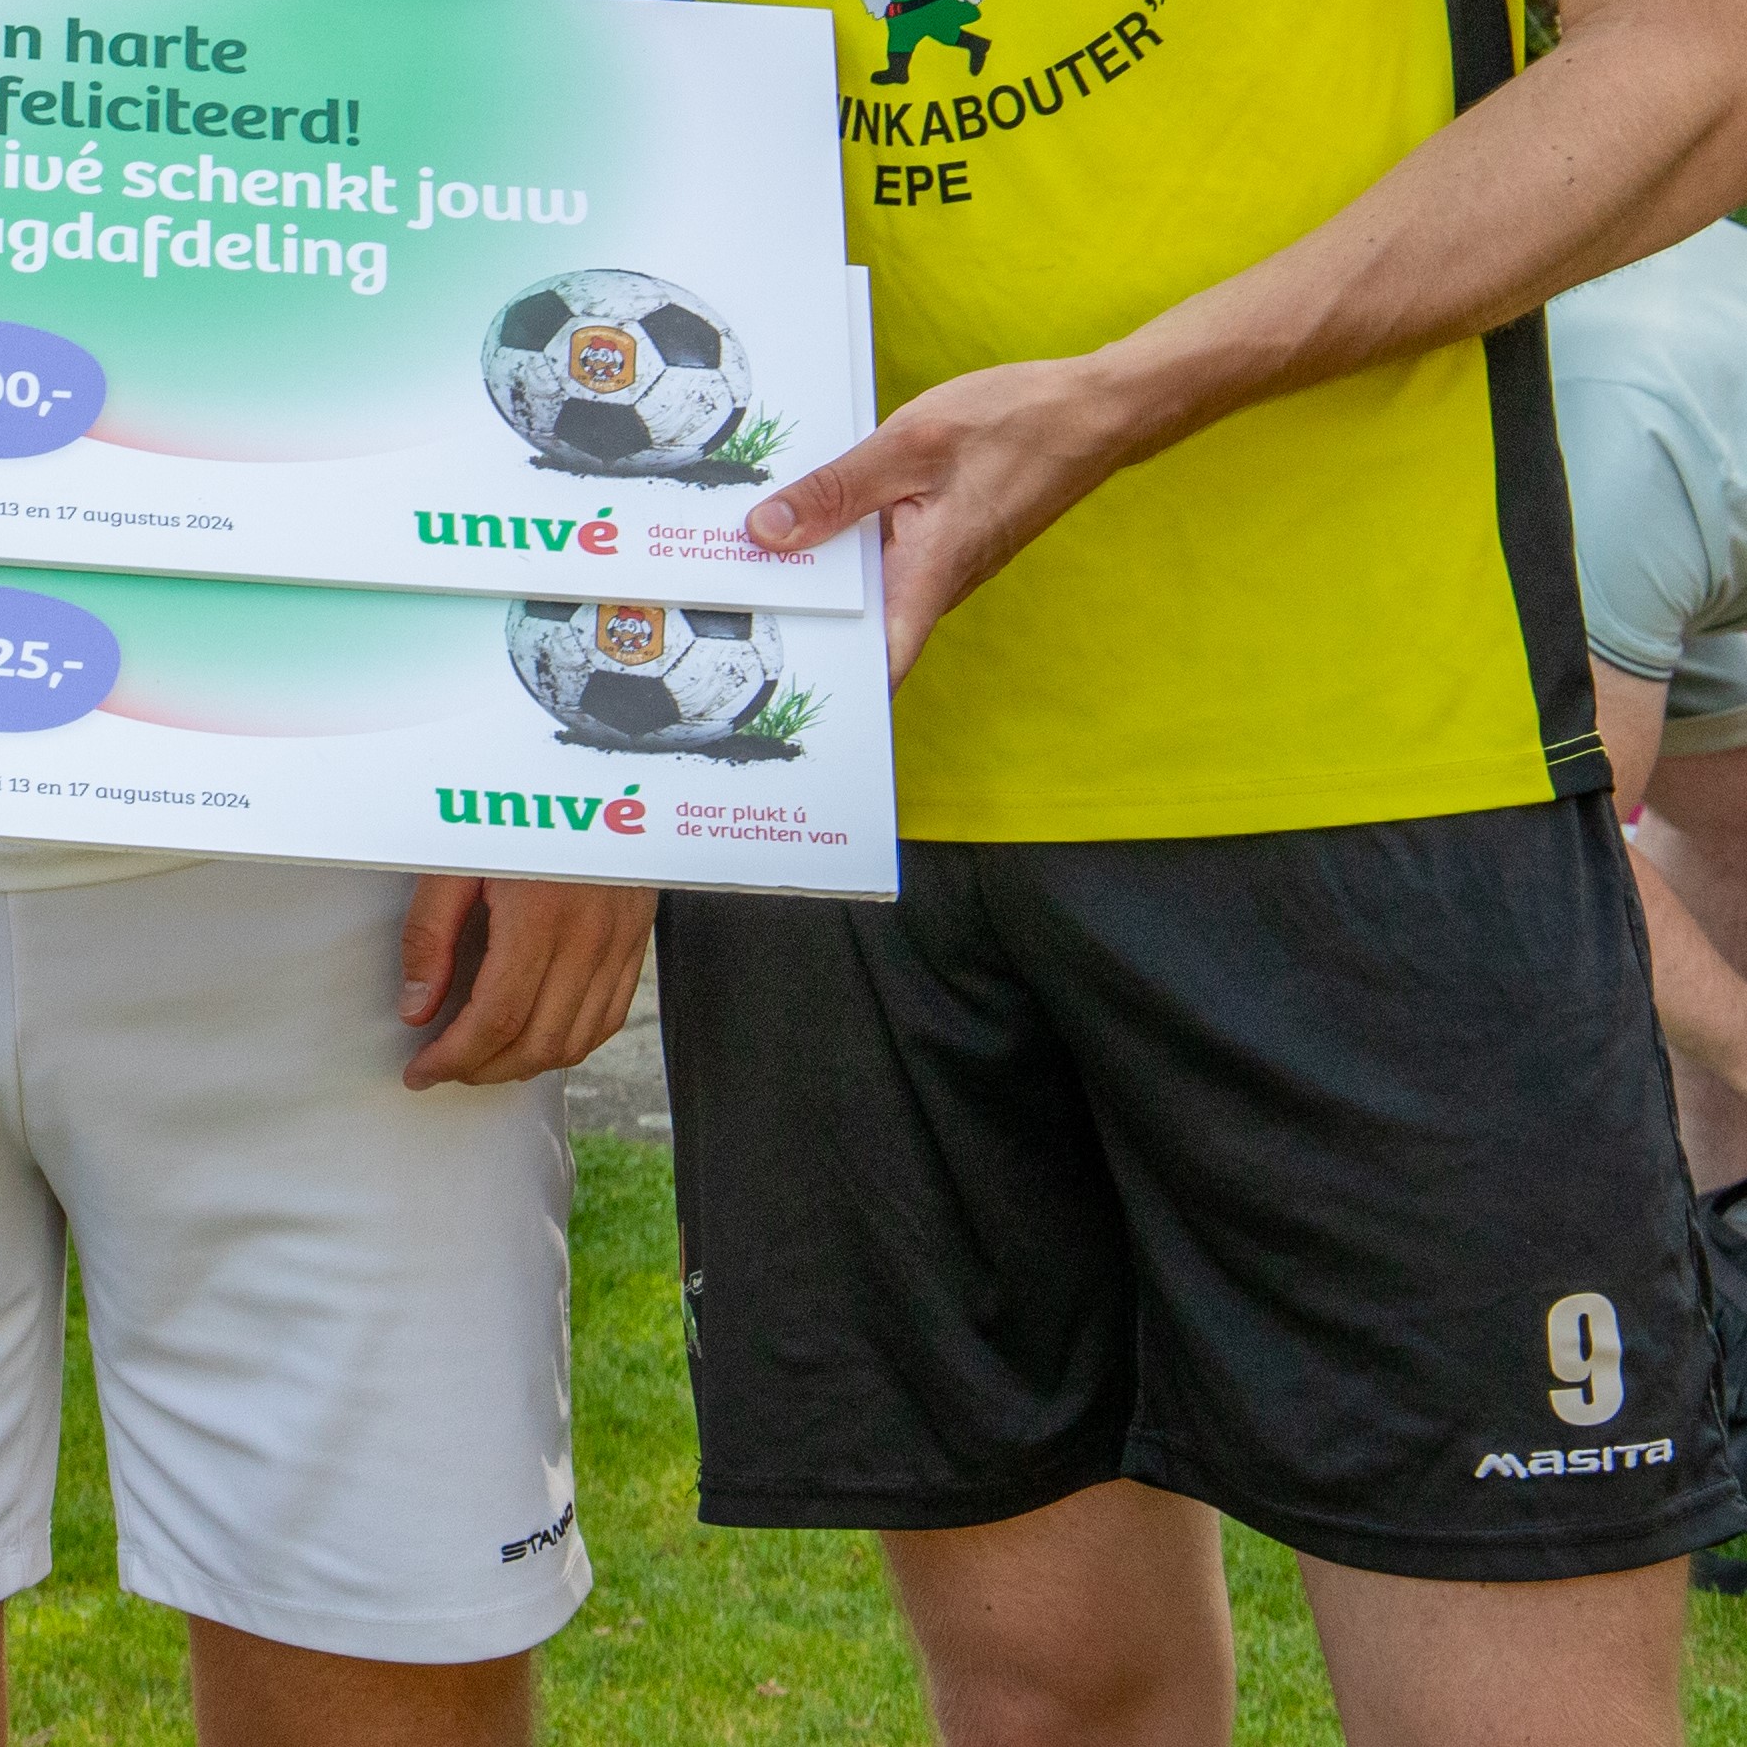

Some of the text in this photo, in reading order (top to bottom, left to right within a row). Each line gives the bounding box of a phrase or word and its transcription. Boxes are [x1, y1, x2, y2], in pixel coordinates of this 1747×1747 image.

[66, 18, 249, 75] harte
[121, 153, 398, 215] schenkt
[408, 166, 589, 230] jouw
[873, 160, 973, 206] EPE
[0, 501, 20, 517] 13
[26, 505, 51, 519] en
[57, 505, 78, 521] 17
[83, 508, 181, 529] augustus
[186, 515, 235, 532] 2024
[414, 506, 620, 556] univé
[648, 523, 749, 545] daar pluk
[648, 542, 674, 558] de
[679, 546, 771, 564] vruchten
[9, 777, 31, 794] 13
[37, 781, 62, 795] en
[68, 781, 90, 798] 17
[95, 784, 196, 807] augustus
[201, 791, 251, 809] 2024
[435, 784, 647, 836] univé
[676, 801, 727, 821] daar
[733, 804, 788, 826] plukt
[676, 821, 848, 846] de vruchten van
[1547, 1292, 1625, 1426] 9
[501, 1501, 574, 1564] STANNO
